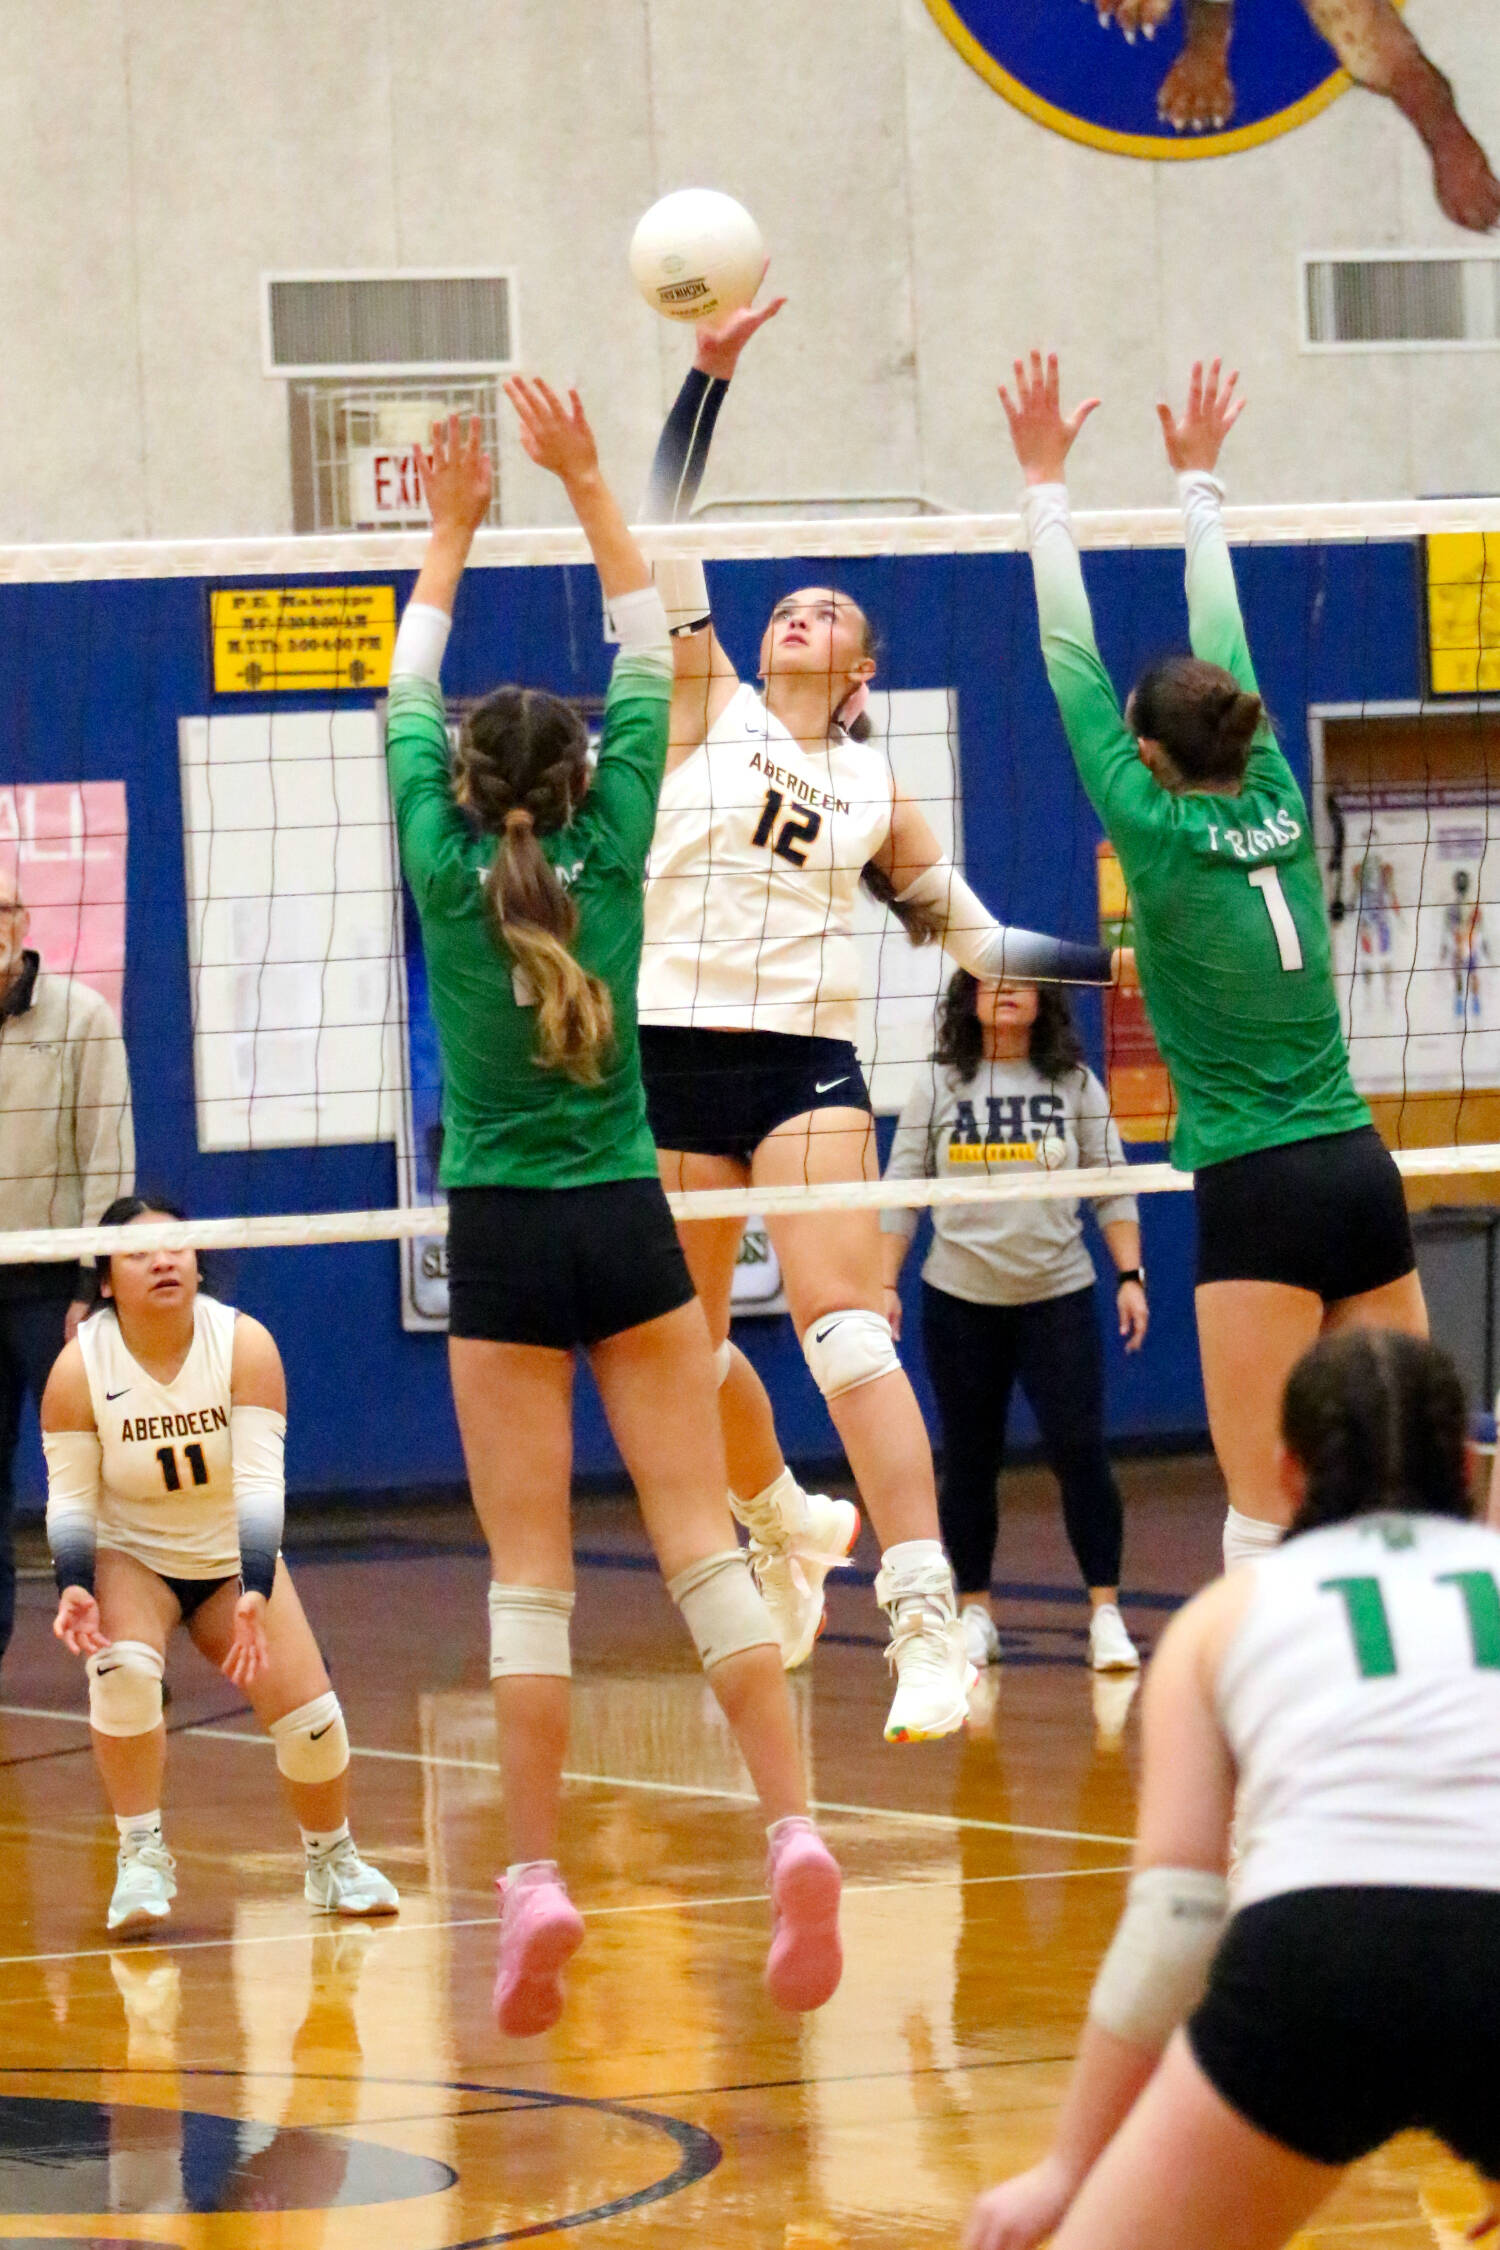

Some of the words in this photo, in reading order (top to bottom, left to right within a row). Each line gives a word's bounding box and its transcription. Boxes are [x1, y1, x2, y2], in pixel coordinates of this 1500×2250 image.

[374, 455, 433, 511] EXI
[749, 752, 850, 816] ABERDEEN
[752, 787, 822, 868] 12
[1248, 865, 1304, 972] 1
[951, 1094, 1065, 1144] AHS
[122, 1406, 228, 1442] ABERDEEN
[156, 1443, 209, 1492] 11
[1318, 1569, 1500, 1679] 11
